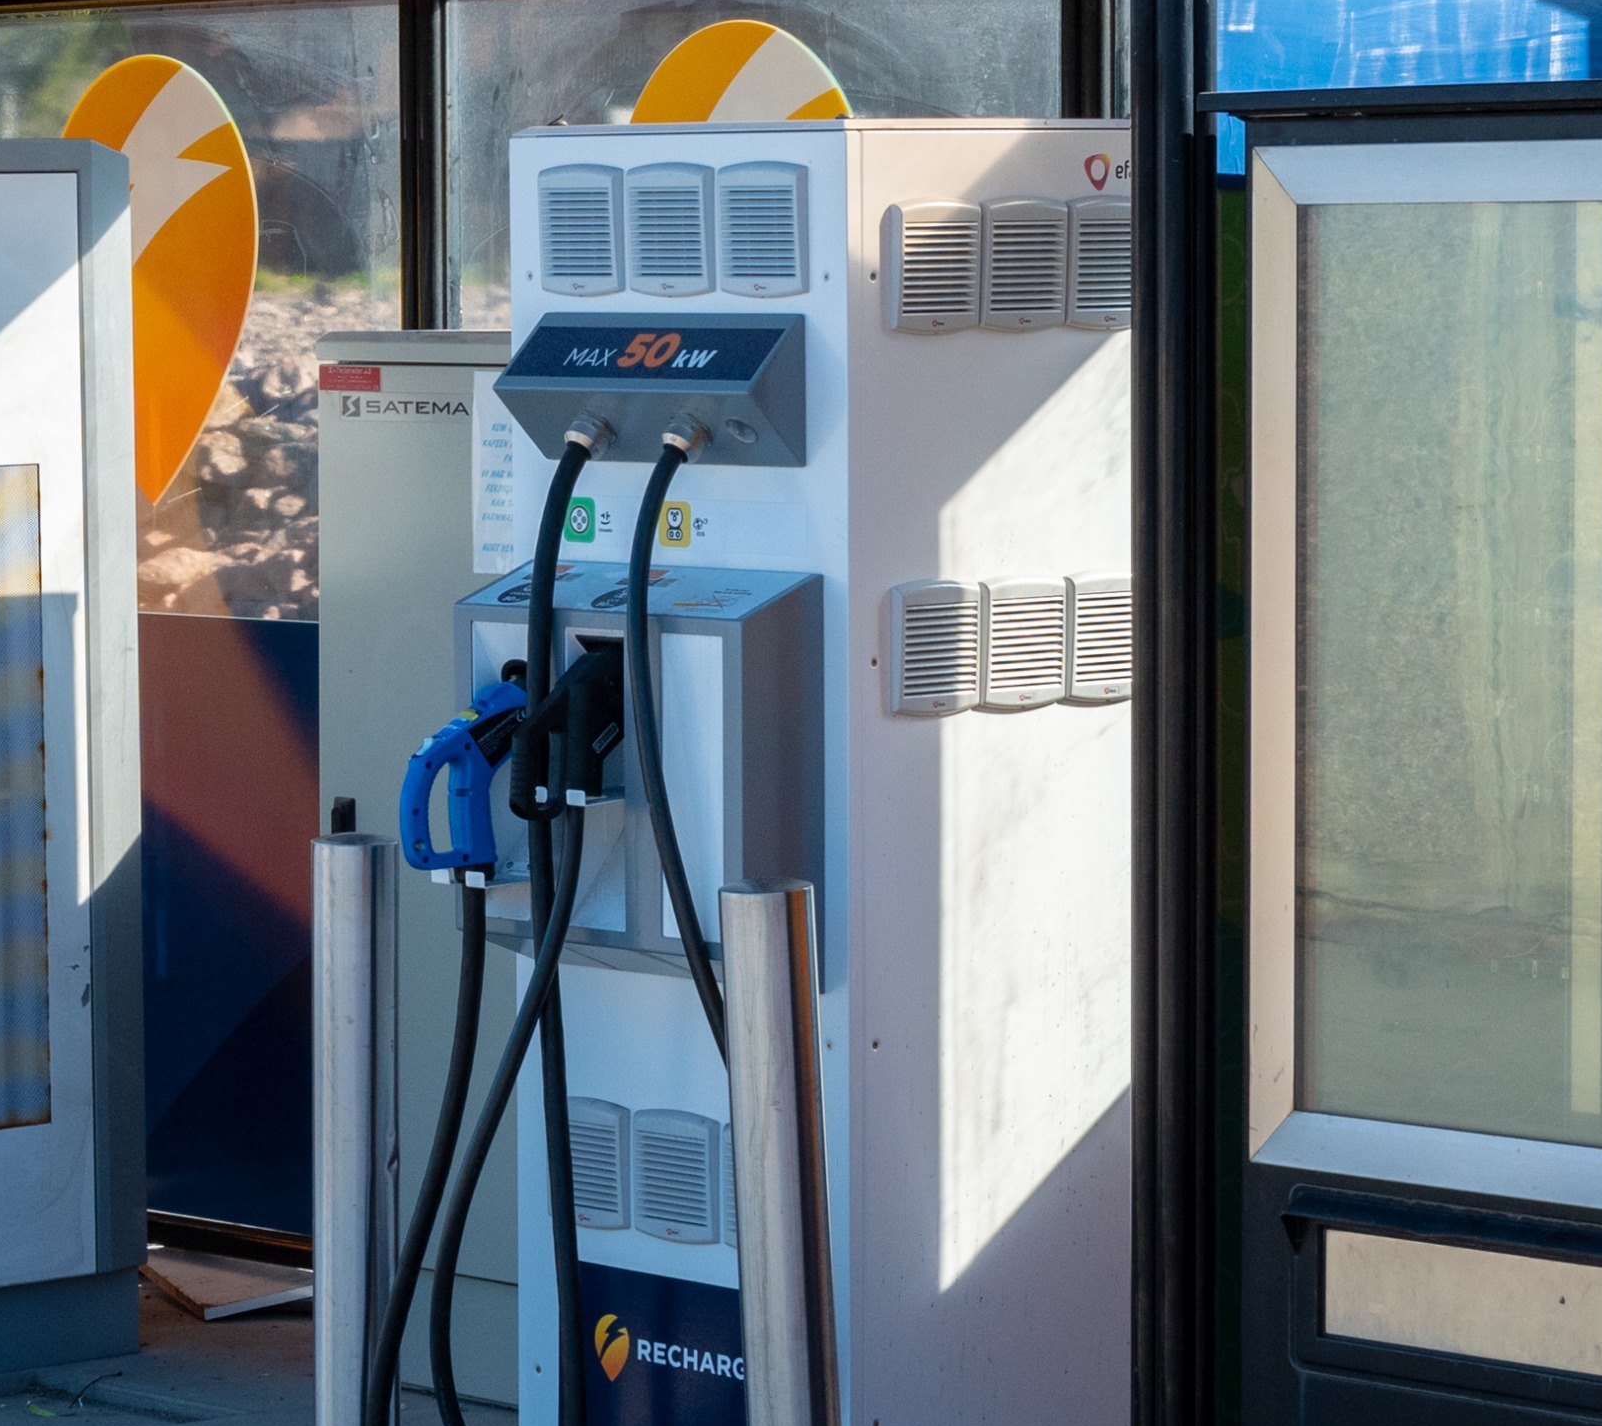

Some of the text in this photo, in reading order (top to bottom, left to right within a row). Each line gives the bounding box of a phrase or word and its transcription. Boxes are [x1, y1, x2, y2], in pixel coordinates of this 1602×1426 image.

[562, 332, 719, 368] MAX 50 kW
[366, 400, 470, 416] SATEMA
[636, 1338, 744, 1380] RECHARG
